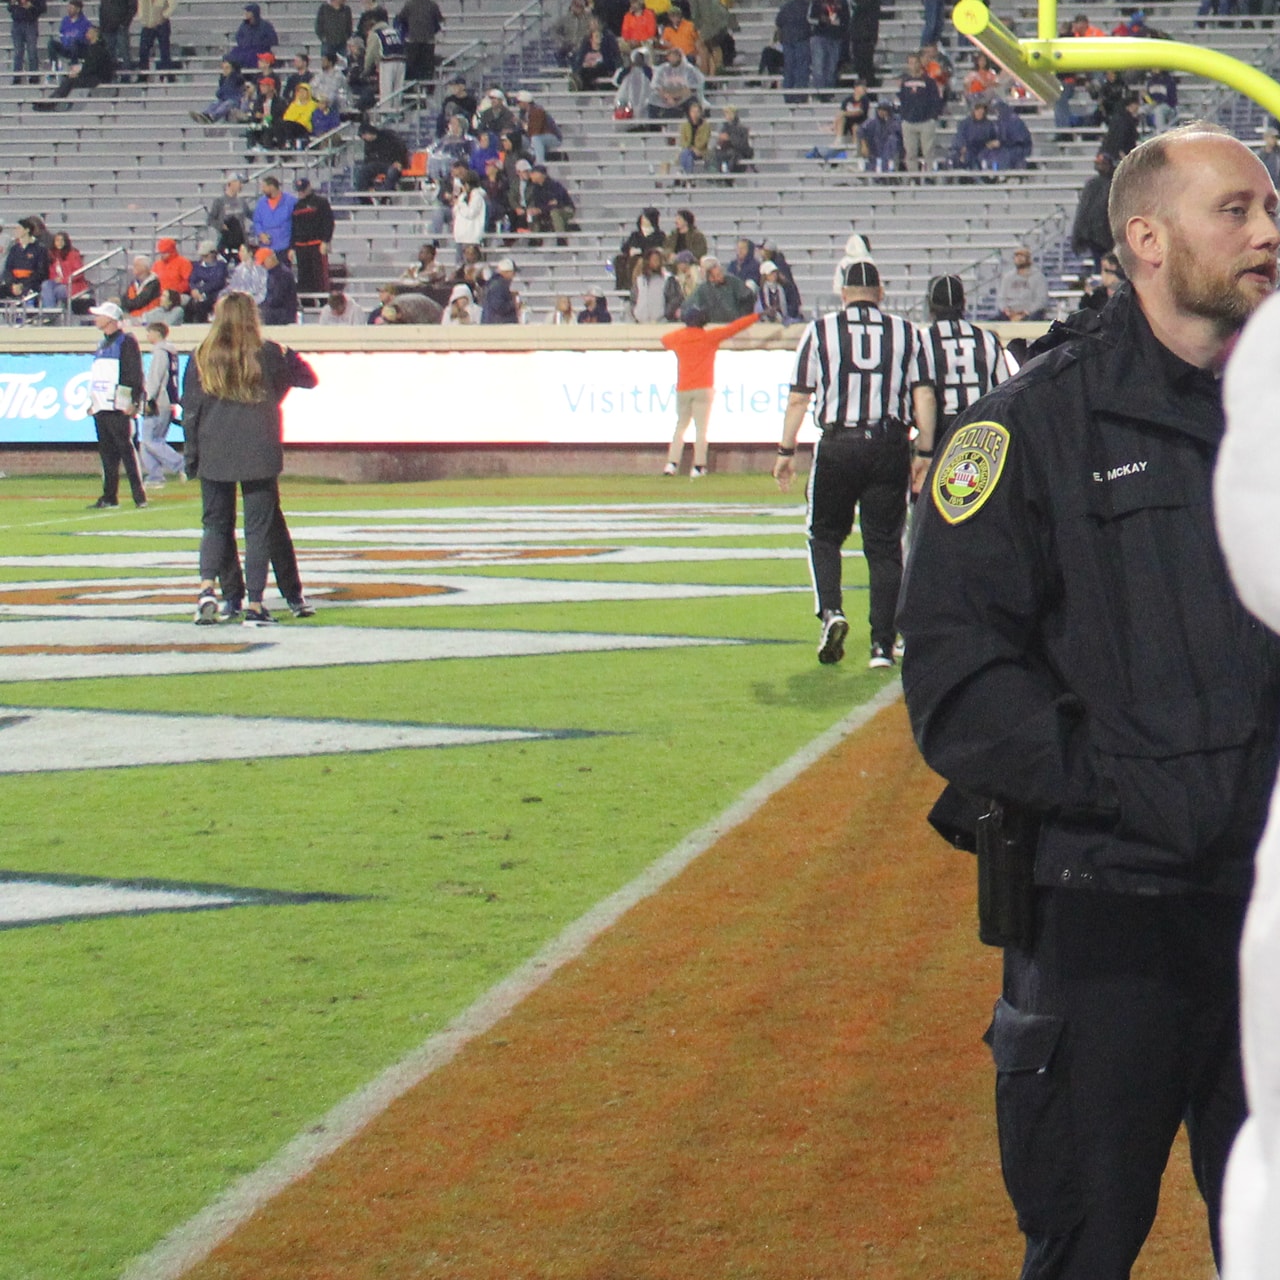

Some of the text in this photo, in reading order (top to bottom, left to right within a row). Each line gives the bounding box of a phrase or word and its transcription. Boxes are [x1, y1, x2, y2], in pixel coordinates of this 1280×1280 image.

[848, 324, 884, 370] U
[941, 338, 980, 384] H
[952, 428, 1003, 463] POLICE
